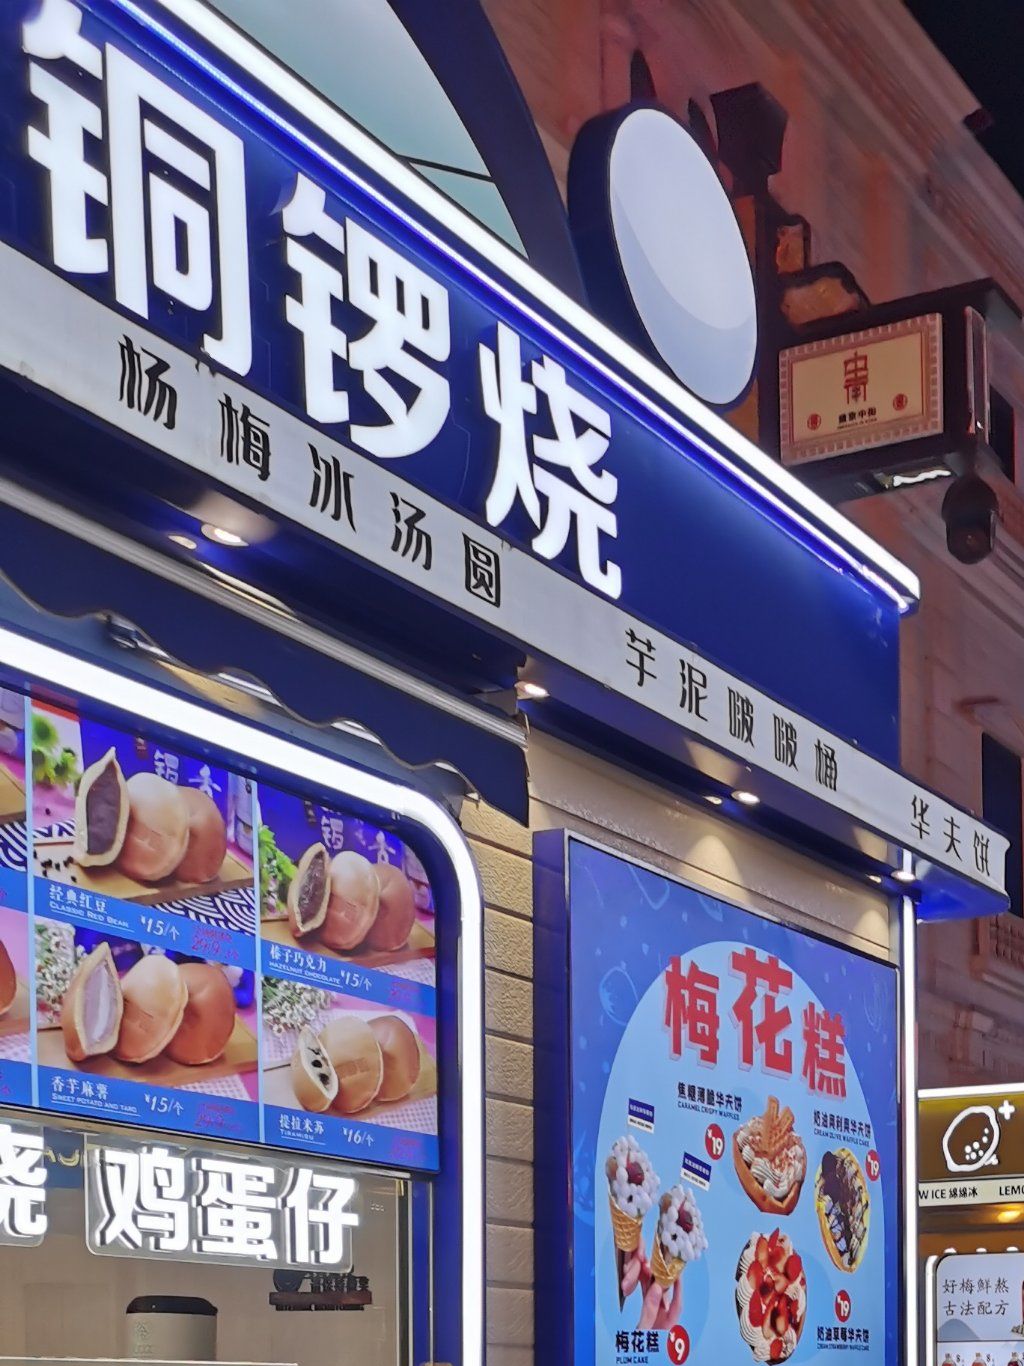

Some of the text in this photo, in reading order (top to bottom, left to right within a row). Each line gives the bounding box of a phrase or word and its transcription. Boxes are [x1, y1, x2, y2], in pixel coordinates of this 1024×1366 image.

[23, 0, 621, 599] 铜锣烧
[119, 336, 500, 608] 杨梅冰汤圆
[625, 628, 838, 792] 芋泥啵啵桶
[912, 794, 991, 877] 华夫饼
[49, 885, 107, 914] 经典红豆
[270, 943, 327, 973] 榛子巧克力
[664, 947, 847, 1099] 梅花糕
[51, 1076, 108, 1100] 香芋麻薯
[279, 1113, 324, 1135] 提拉米苏
[95, 1147, 359, 1265] 鸡蛋仔
[931, 1188, 946, 1199] ICE
[943, 1299, 1010, 1317] 古法配方
[615, 1331, 660, 1354] 梅花糕
[616, 1356, 649, 1365] PLUM CAKE
